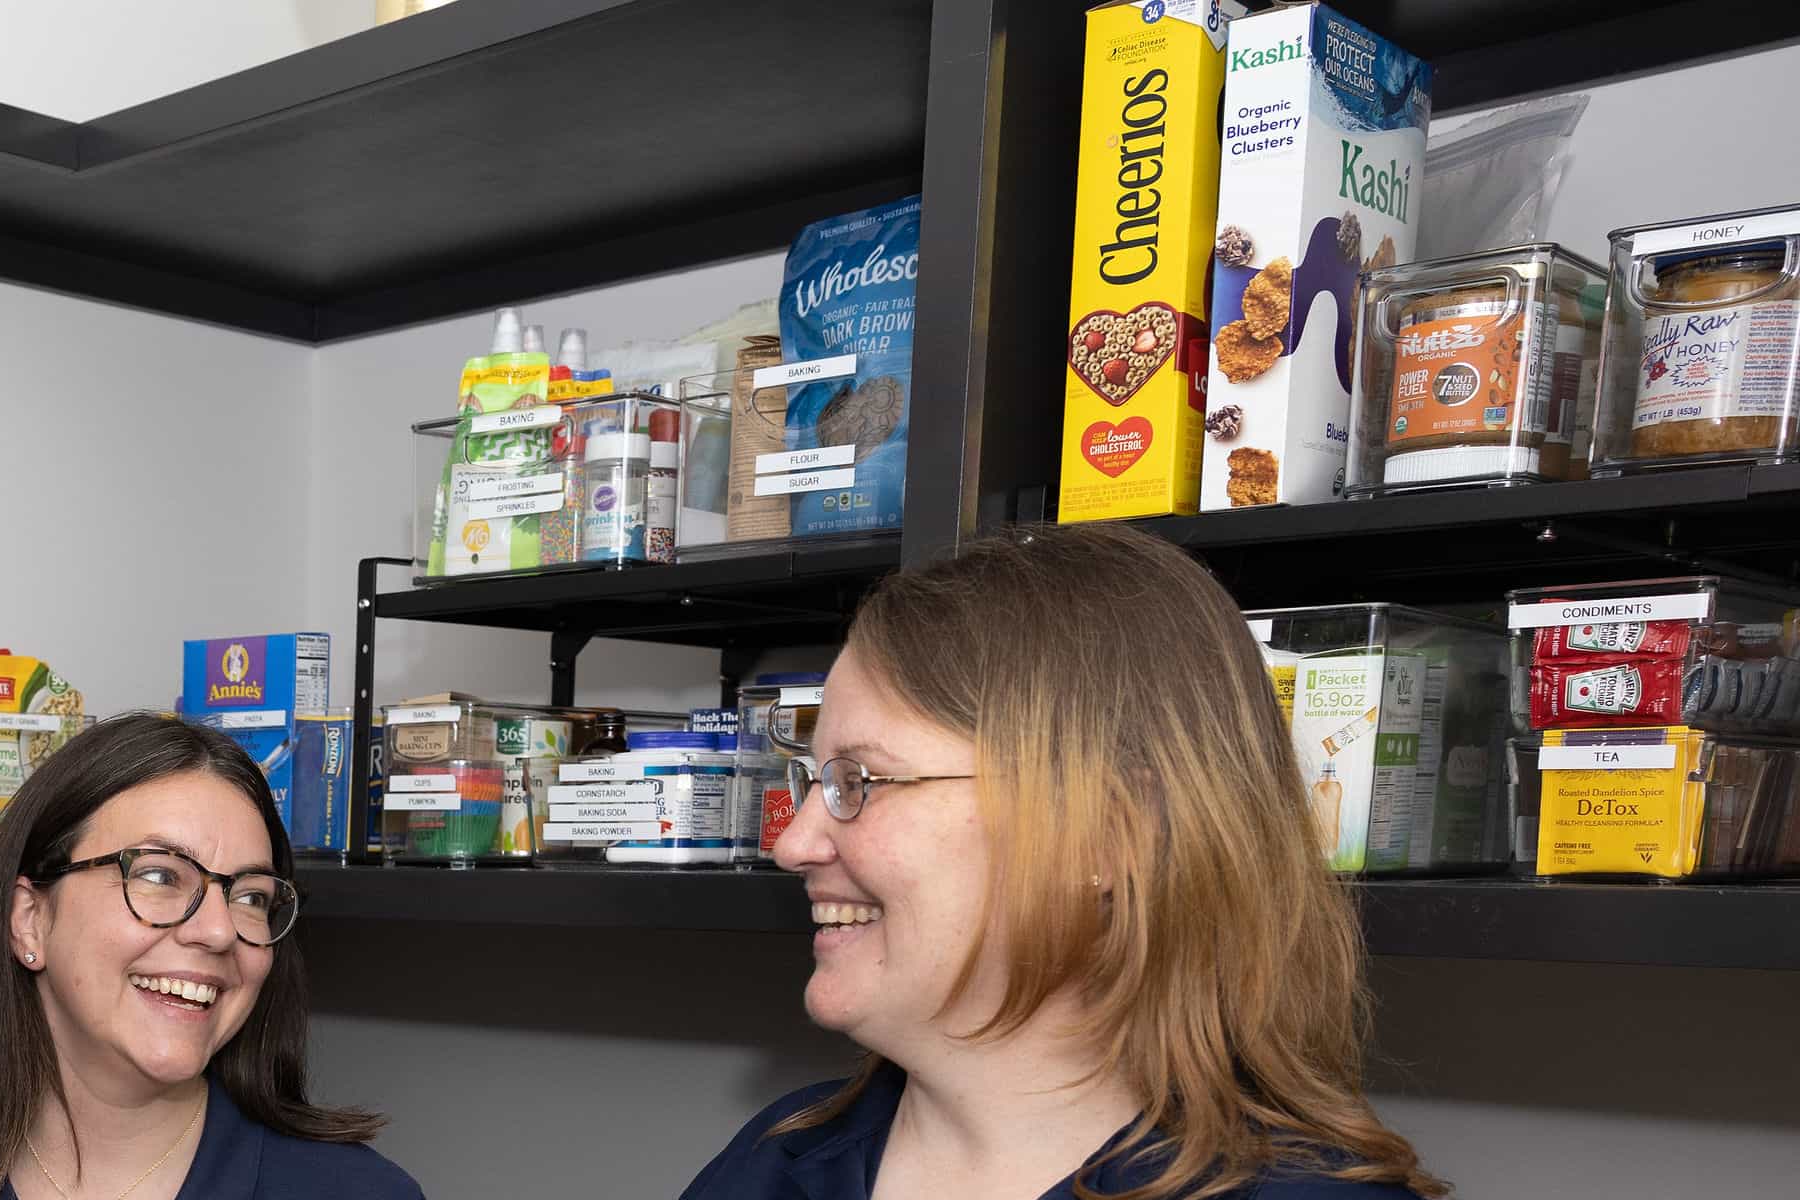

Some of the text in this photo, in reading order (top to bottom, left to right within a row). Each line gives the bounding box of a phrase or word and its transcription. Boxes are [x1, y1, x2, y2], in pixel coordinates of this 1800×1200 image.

[1140, 37, 1166, 48] Disease
[1231, 35, 1305, 72] Kashi
[1326, 34, 1376, 75] PROTECT
[1325, 59, 1342, 78] OUR
[1343, 67, 1375, 93] OCEANS
[1239, 100, 1291, 119] Organic
[1226, 115, 1302, 139] Blueberry
[1231, 135, 1294, 156] Clusters
[1099, 67, 1169, 286] Cheerios
[1339, 139, 1411, 224] Kashi
[1693, 225, 1744, 241] HONEY
[823, 300, 888, 324] ORGANIC FAIR
[822, 312, 915, 348] DARK BROW
[1684, 312, 1739, 336] Raw
[1418, 351, 1456, 361] ORGANIC
[1677, 340, 1739, 359] HONEY
[789, 365, 821, 377] BAKING
[1400, 369, 1429, 385] POWER
[1452, 375, 1473, 384] NUT
[1399, 383, 1426, 397] FUEL
[499, 413, 535, 425] BAKING
[1108, 430, 1142, 442] lower
[1090, 440, 1142, 456] CHOLESTEROL
[790, 454, 819, 465] FLOUR
[498, 481, 535, 492] FROSTING
[789, 477, 820, 488] SUGAR
[497, 501, 536, 513] SPRINKLES
[1562, 603, 1652, 619] CONDIMENTS
[1319, 674, 1367, 685] Packet
[208, 681, 263, 702] Annie's
[1597, 677, 1608, 706] KETCHUP
[1605, 675, 1618, 707] TOMATO
[1623, 676, 1635, 705] HEINZ
[1305, 692, 1365, 708] 16.9oz
[693, 713, 719, 723] Hack
[1305, 709, 1328, 717] bottle
[499, 728, 529, 743] 365
[327, 727, 340, 774] RONZONI
[1594, 752, 1619, 762] TEA
[588, 768, 615, 776] BAKING
[576, 790, 626, 798] CORNSTARCH
[1558, 788, 1664, 798] Roasted Dandelion Spice
[578, 809, 627, 817] BAKING SODA
[1577, 799, 1640, 816] DeTox
[572, 827, 632, 835] BAKING POWDER
